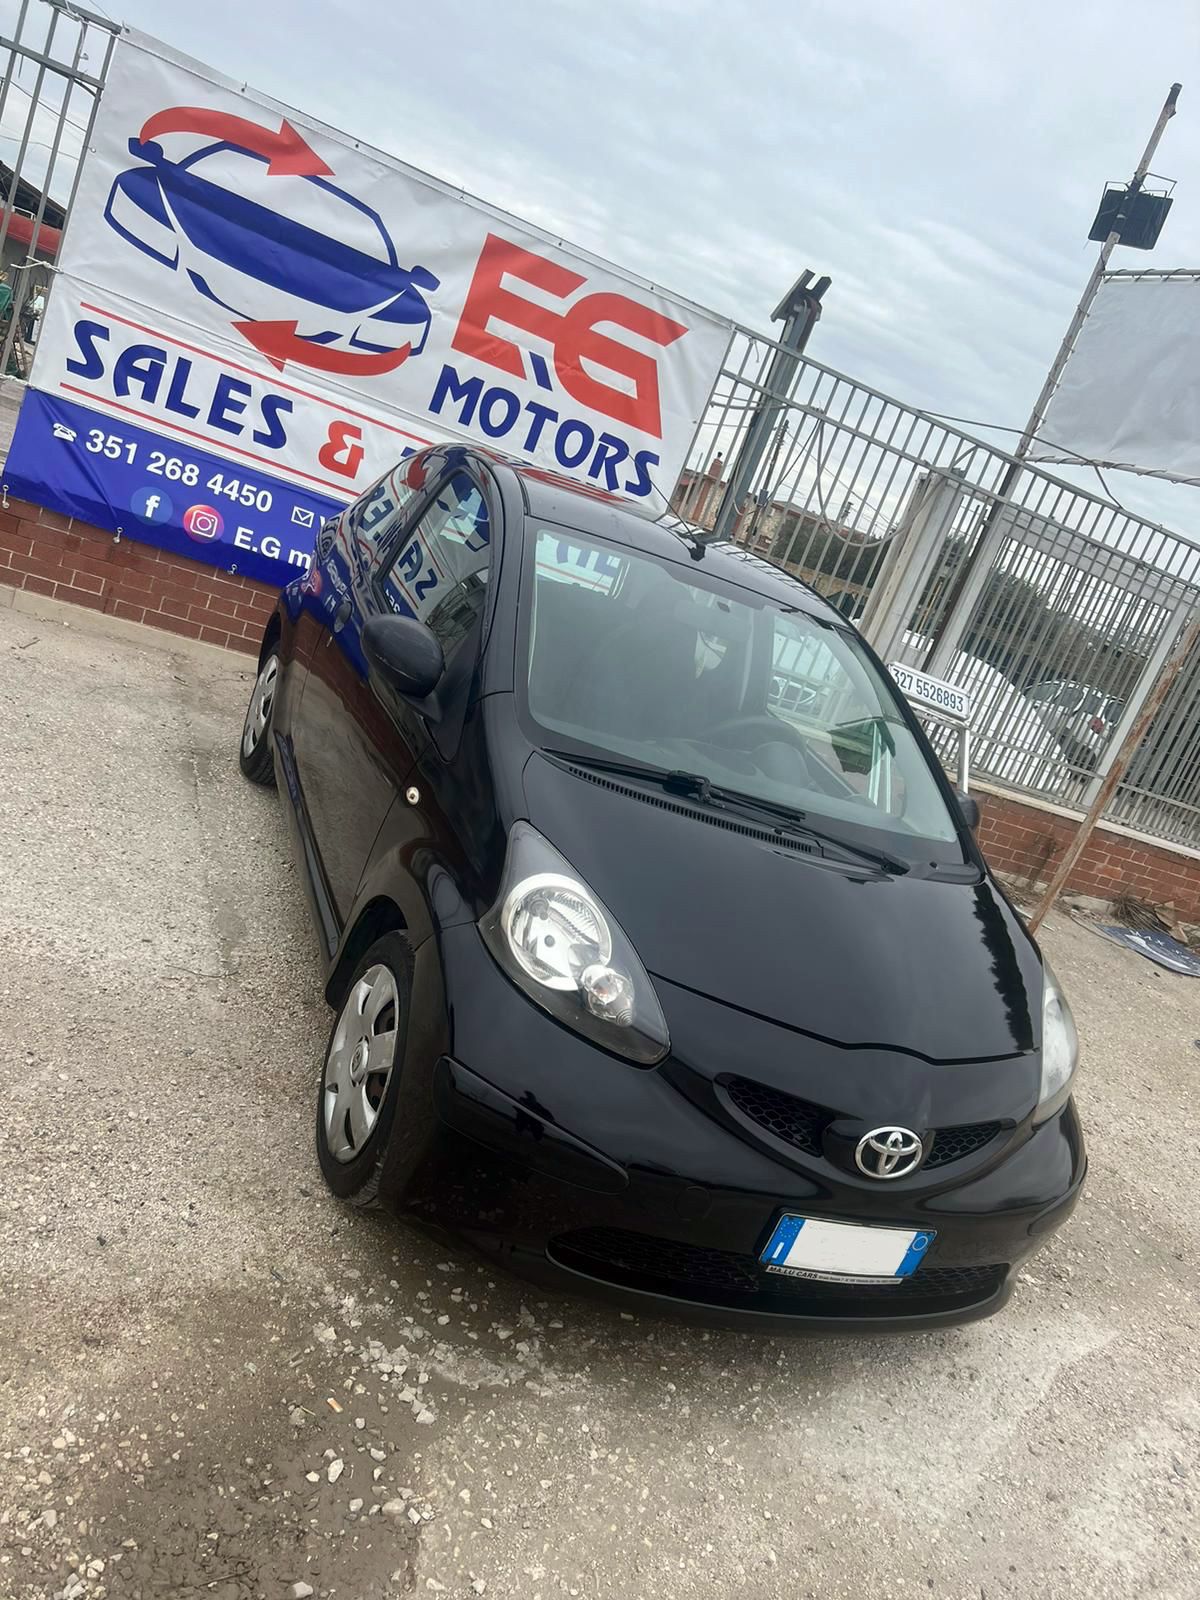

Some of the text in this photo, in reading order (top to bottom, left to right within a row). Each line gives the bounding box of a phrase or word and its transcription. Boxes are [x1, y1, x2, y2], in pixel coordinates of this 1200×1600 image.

[66, 320, 364, 479] SALES &
[428, 364, 660, 497] MOTORS
[85, 429, 273, 512] 351 268 4450
[234, 526, 311, 570] E.G m
[893, 668, 963, 712] 327 5526893
[796, 1271, 818, 1279] CARS
